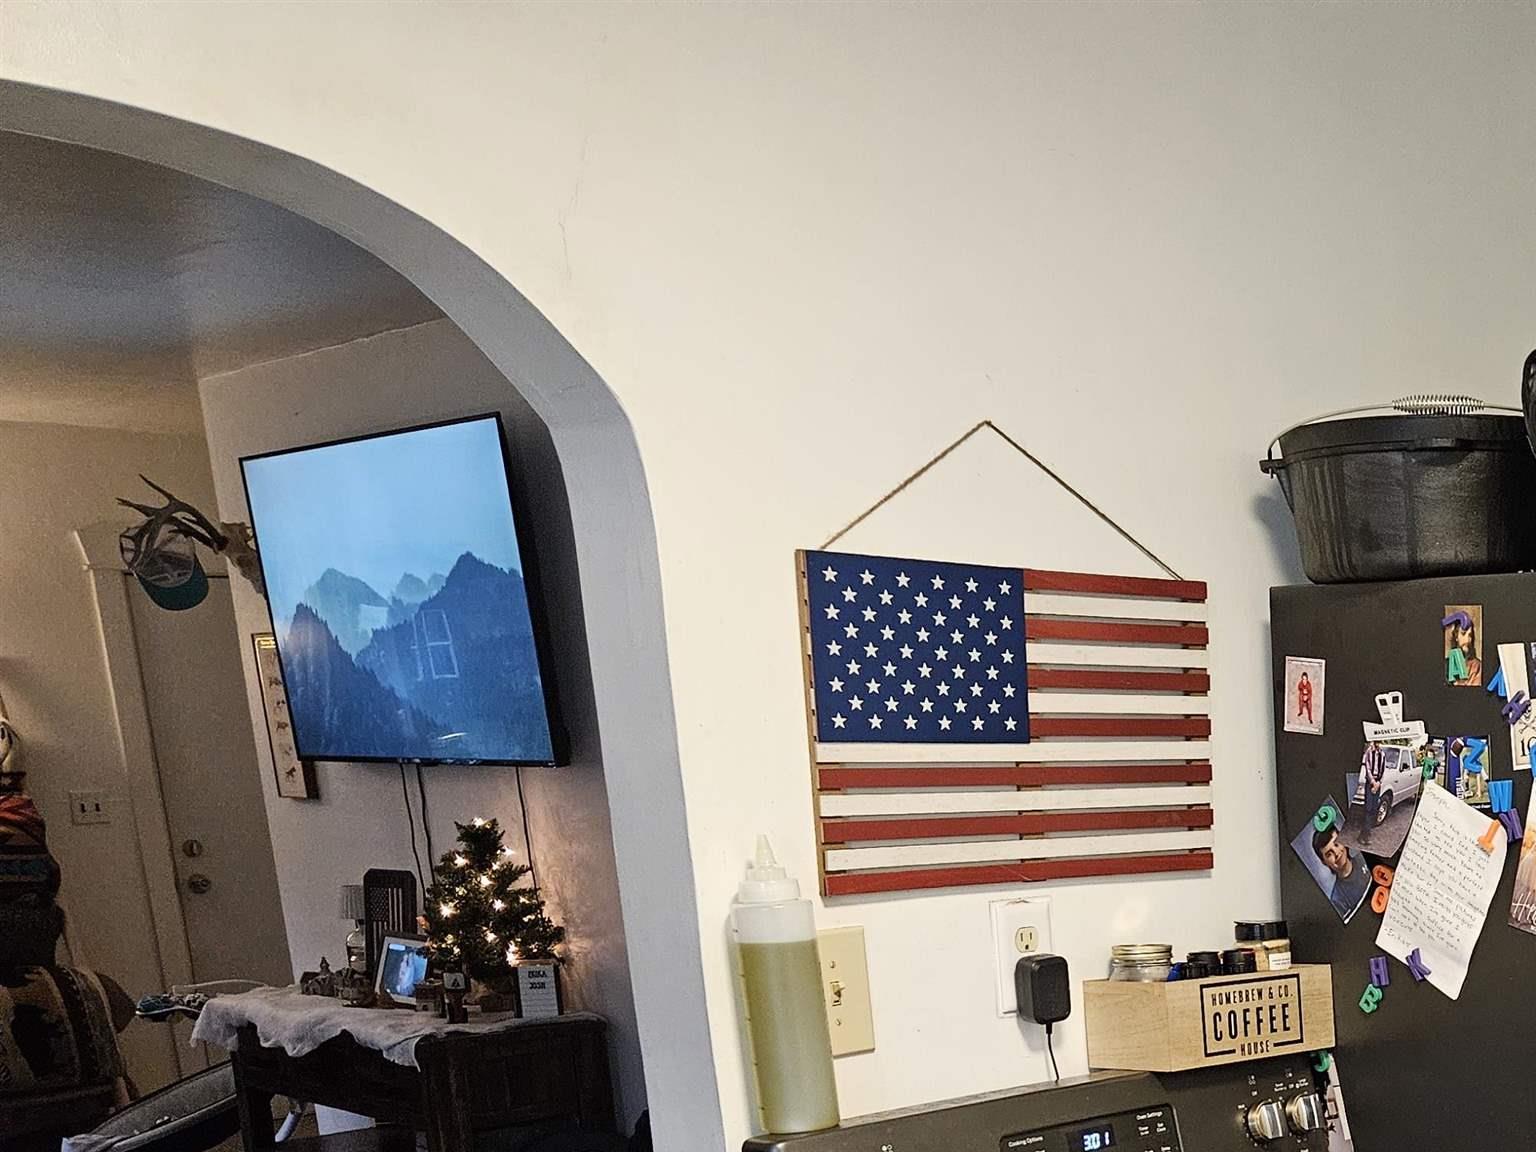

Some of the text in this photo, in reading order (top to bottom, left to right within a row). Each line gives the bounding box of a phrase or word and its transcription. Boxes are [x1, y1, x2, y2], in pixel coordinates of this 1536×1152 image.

[1211, 984, 1294, 1006] HOMEBREW & CO.
[1212, 1003, 1291, 1042] COFFEE
[1240, 1040, 1271, 1056] HOUSE
